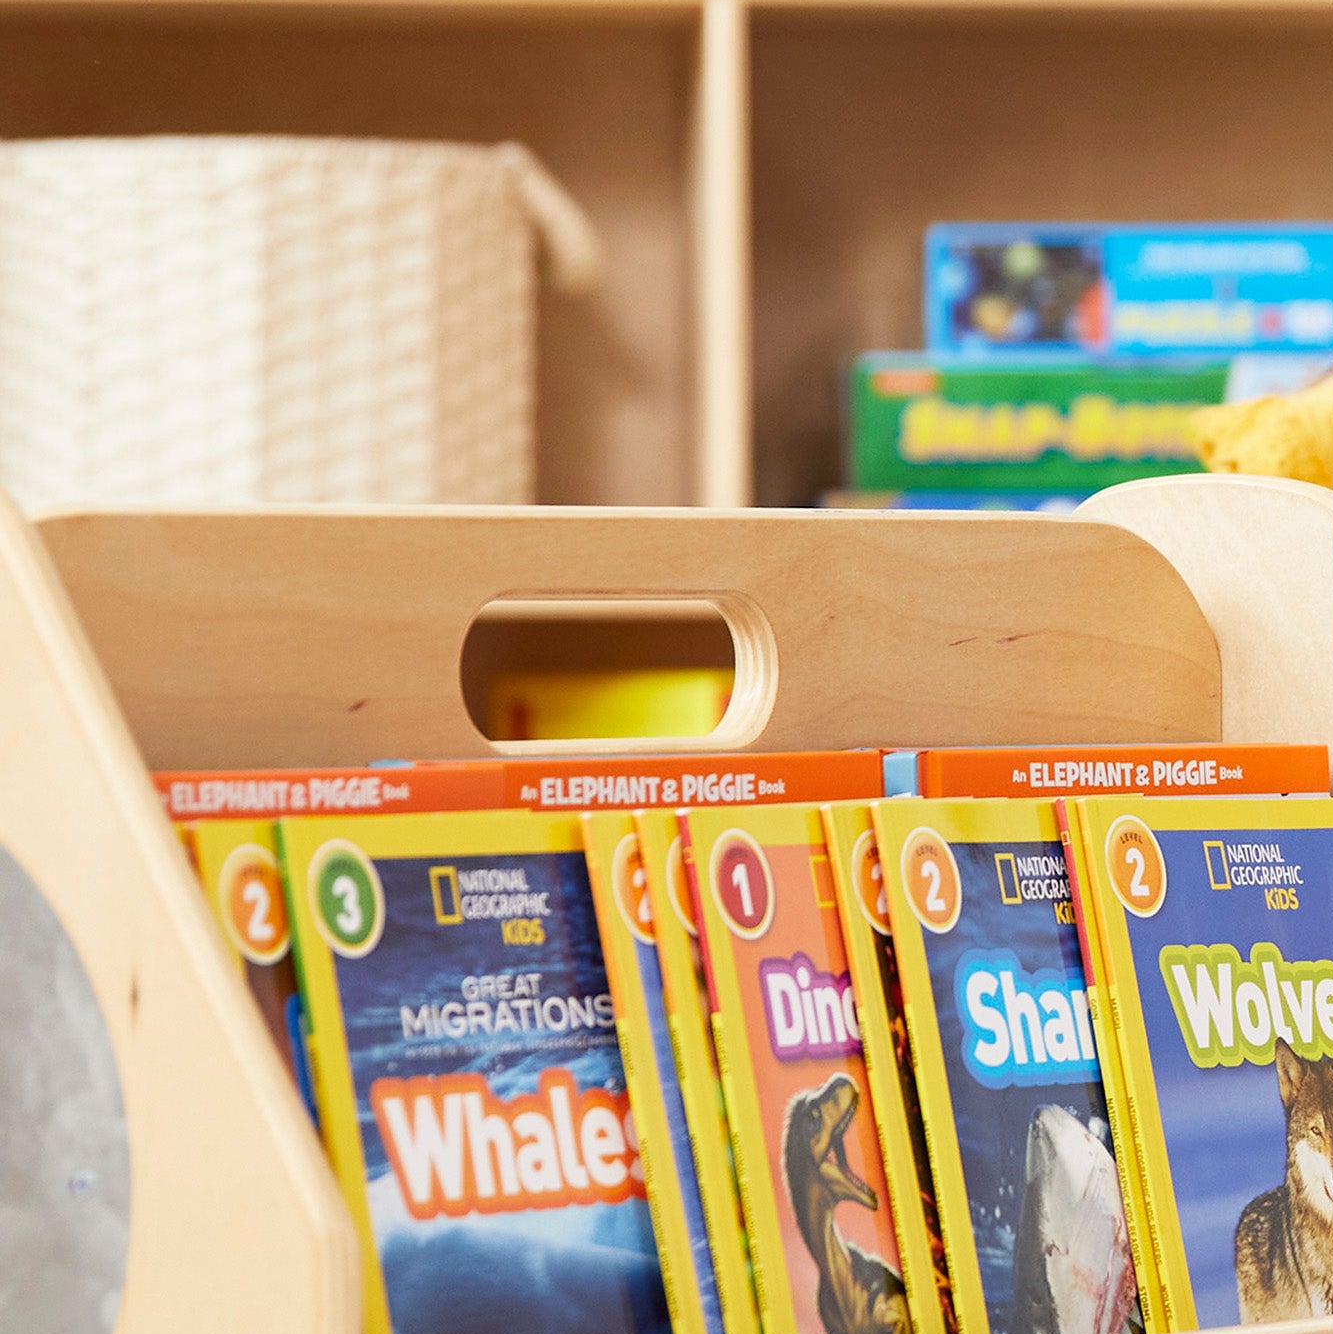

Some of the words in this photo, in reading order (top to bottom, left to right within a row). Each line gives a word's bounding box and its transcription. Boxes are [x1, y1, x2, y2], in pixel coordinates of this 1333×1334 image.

[520, 785, 538, 800] An
[540, 776, 660, 805] ELEPHANT
[661, 779, 679, 802] &
[681, 773, 755, 803] PIGGIE
[758, 779, 785, 795] Book
[1012, 769, 1027, 784] An
[1029, 762, 1133, 787] ELEPHANT
[1135, 764, 1150, 786] &
[1152, 760, 1217, 786] PIGGIE
[1219, 766, 1243, 781] Book
[170, 780, 289, 813] ELEPHANT
[290, 783, 307, 809] &
[309, 777, 382, 809] PIGGIE
[1119, 832, 1144, 845] LEVEL
[1226, 844, 1284, 863] NATIONAL
[457, 868, 530, 893] NATIONAL
[731, 863, 754, 917] 1
[920, 860, 946, 912] 2
[1125, 847, 1150, 897] 2
[1230, 865, 1304, 886] GEOGRAPHIC
[242, 880, 275, 940] 2
[332, 875, 363, 934] 3
[461, 892, 551, 920] GEOGRAPHIC
[461, 973, 543, 1002] GREAT
[401, 993, 615, 1039] MIGRATIONS
[966, 970, 1096, 1067] Shar
[1106, 1098, 1119, 1140] NATIONAL
[1114, 1144, 1130, 1201] GEOGRAPHIC
[1126, 1096, 1140, 1139] NATIONAL
[1134, 1143, 1151, 1198] GEOGRAPHIC
[1149, 1223, 1163, 1265] READERS
[1124, 1202, 1134, 1223] KIDS
[1127, 1225, 1141, 1267] READERS
[1138, 1286, 1150, 1322] STORMS
[1160, 1283, 1173, 1321] WOLVES
